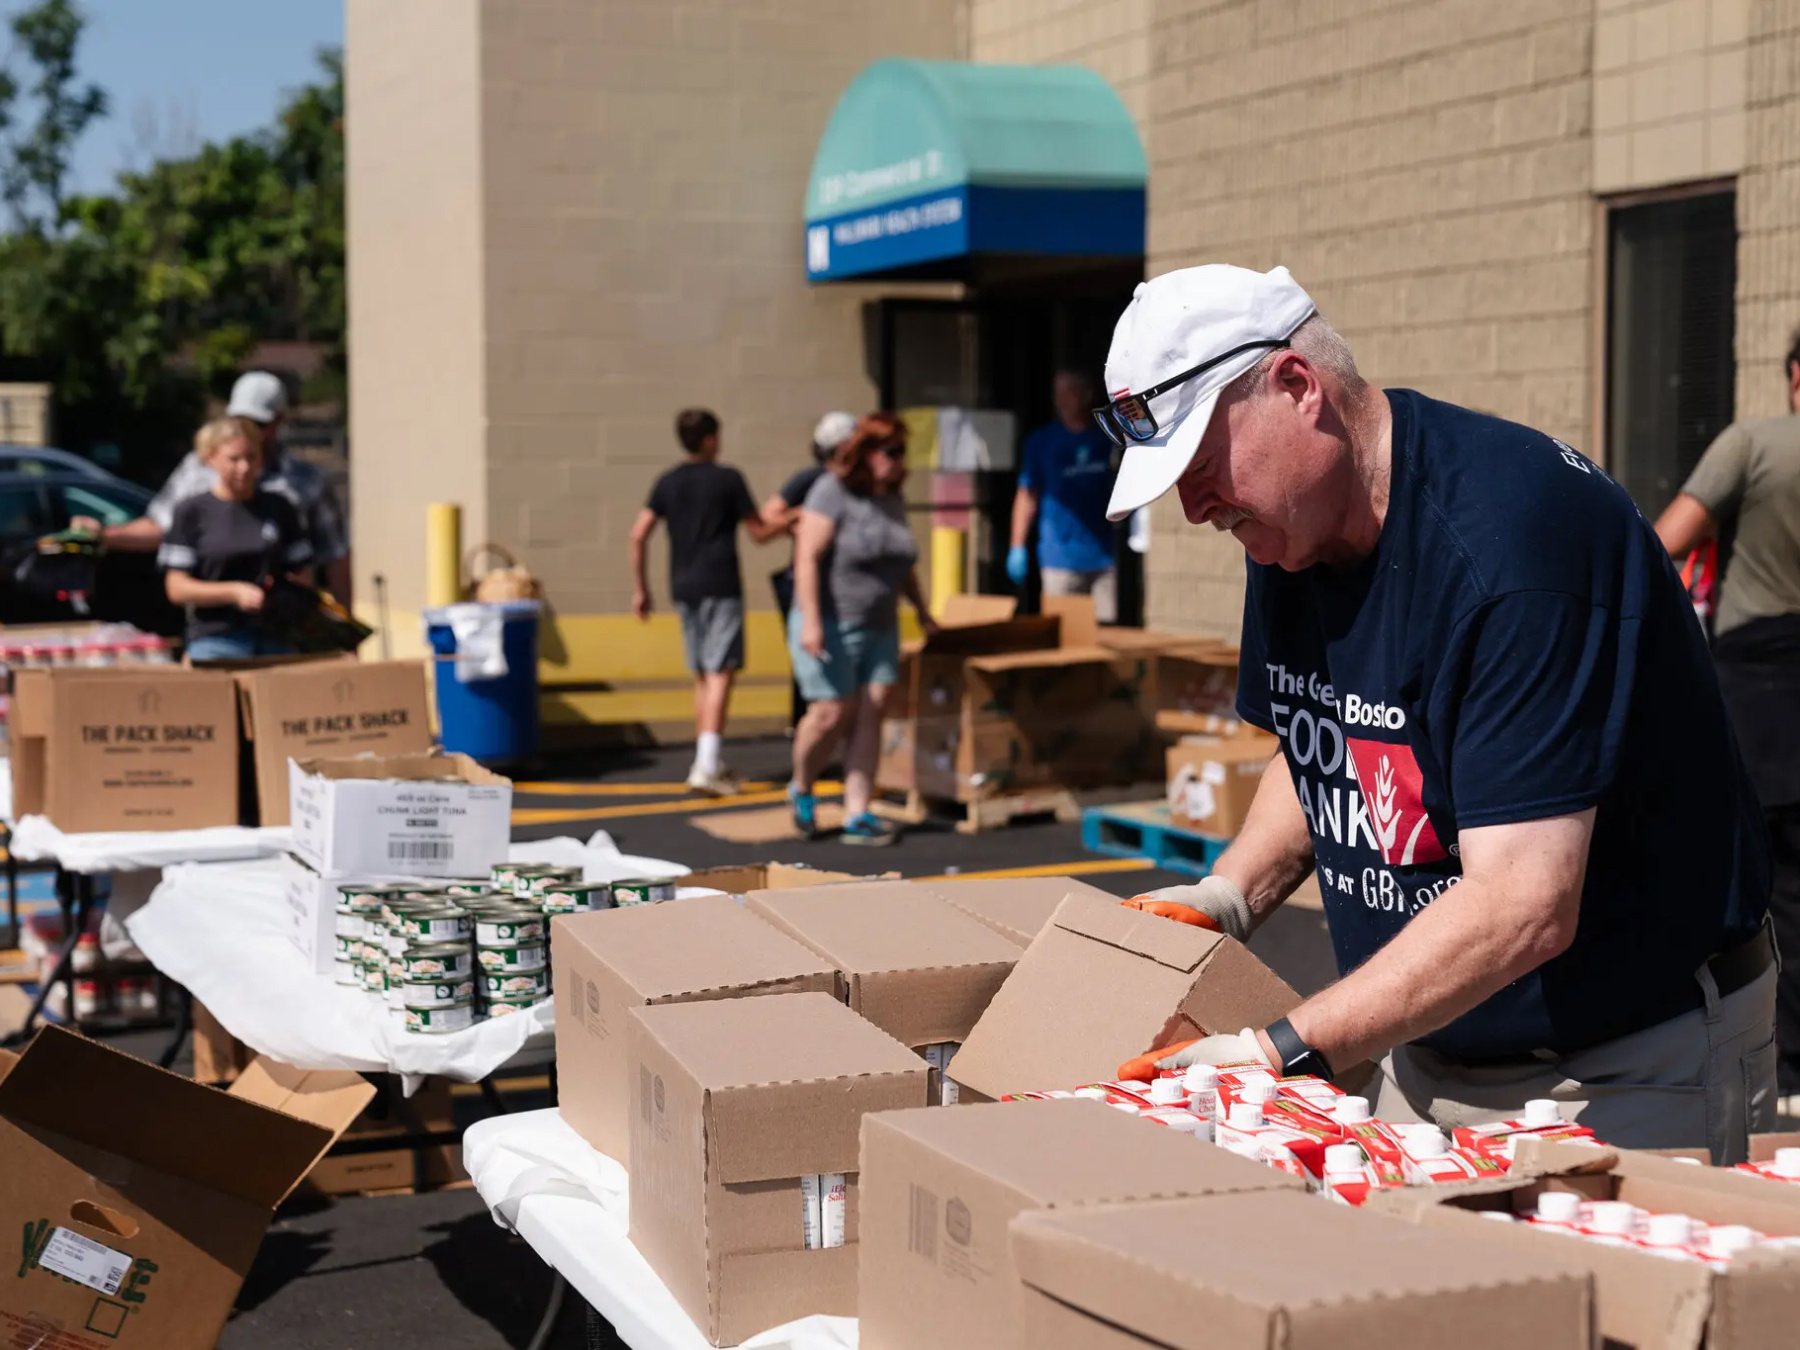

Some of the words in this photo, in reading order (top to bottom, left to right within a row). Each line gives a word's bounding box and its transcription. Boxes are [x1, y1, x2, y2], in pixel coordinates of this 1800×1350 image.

[1266, 662, 1305, 697] The
[1344, 693, 1406, 730] Bosto
[82, 724, 109, 743] THE
[115, 724, 157, 742] PACK
[163, 724, 215, 742] SHACK
[281, 718, 308, 737] THE
[313, 713, 355, 733] PACK
[359, 708, 409, 729] SHACK
[443, 807, 467, 815] TUNA
[1300, 775, 1380, 850] ANK
[1337, 873, 1355, 896] AT
